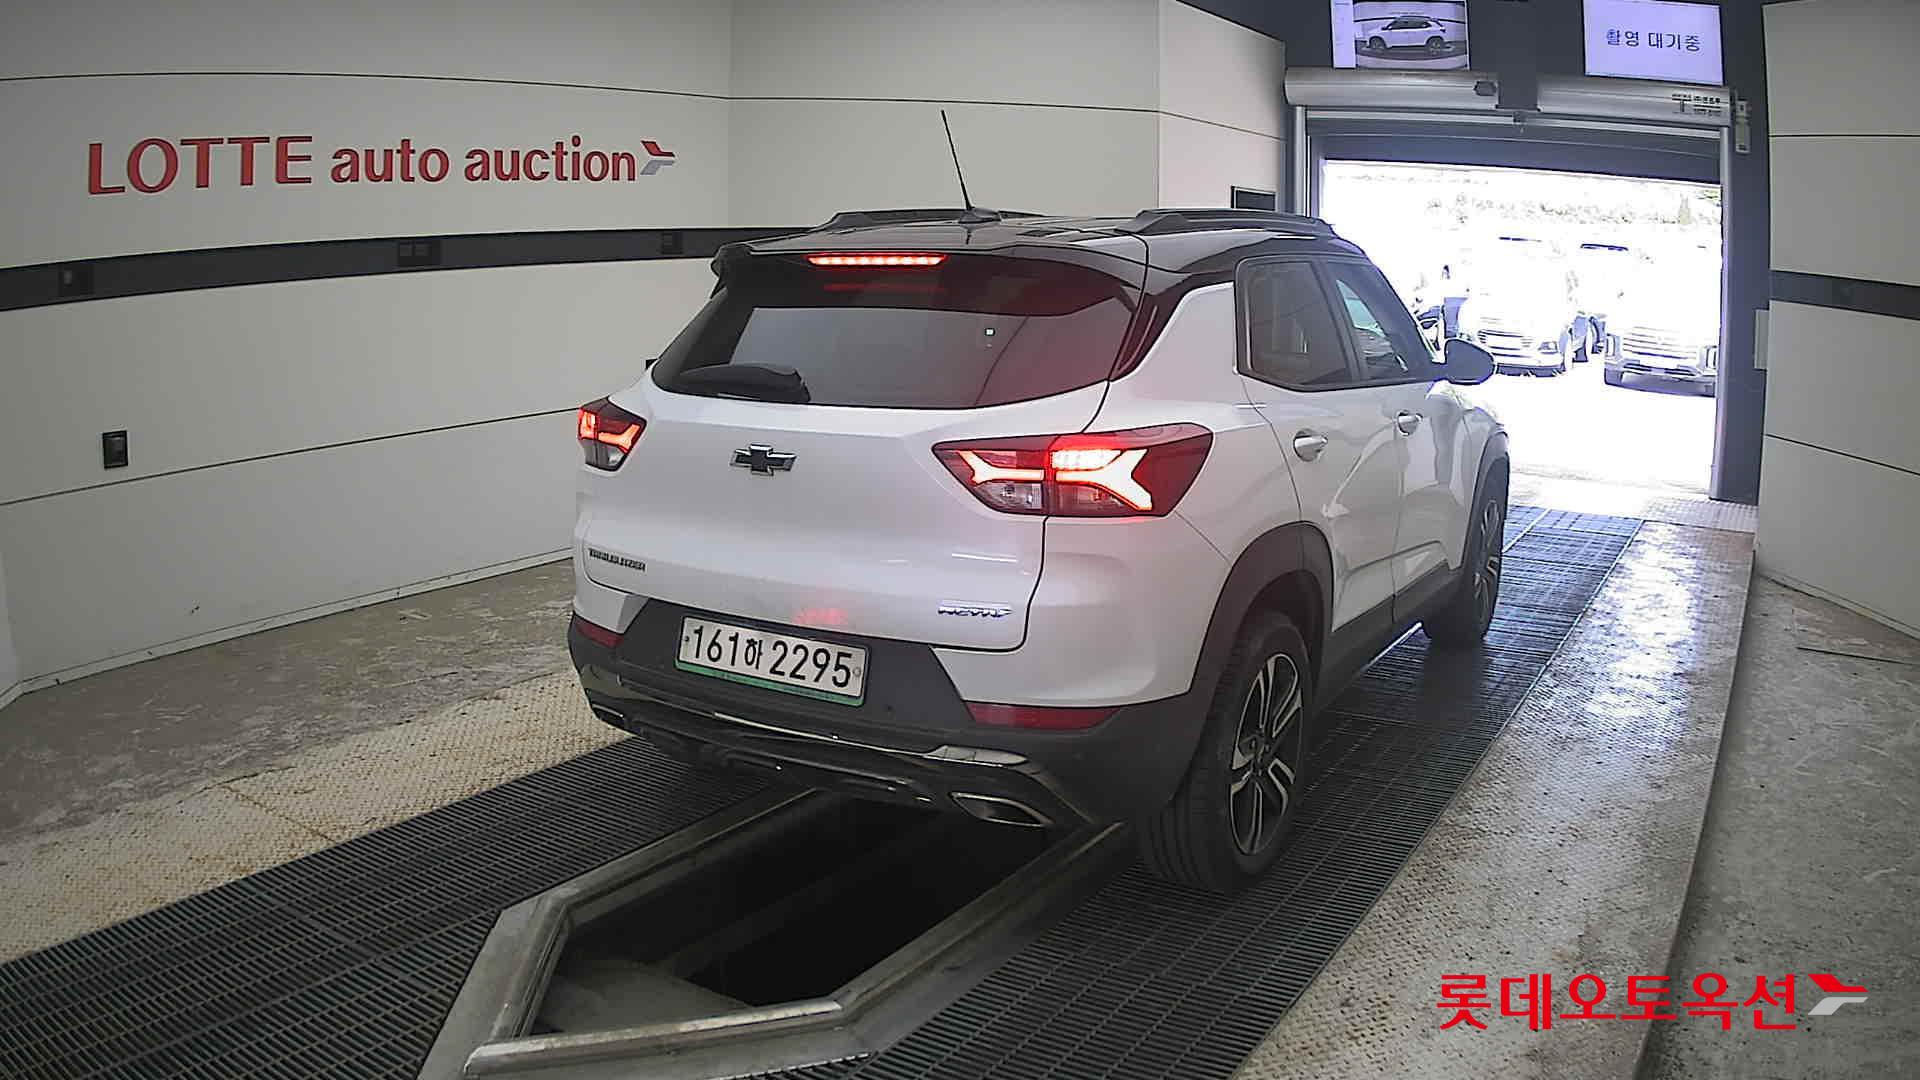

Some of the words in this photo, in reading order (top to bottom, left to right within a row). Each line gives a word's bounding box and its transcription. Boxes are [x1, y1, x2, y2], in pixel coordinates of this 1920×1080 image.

[1647, 31, 1701, 52] 대기중
[88, 135, 313, 195] LOTTE
[330, 138, 450, 183] auto
[463, 135, 637, 183] auction
